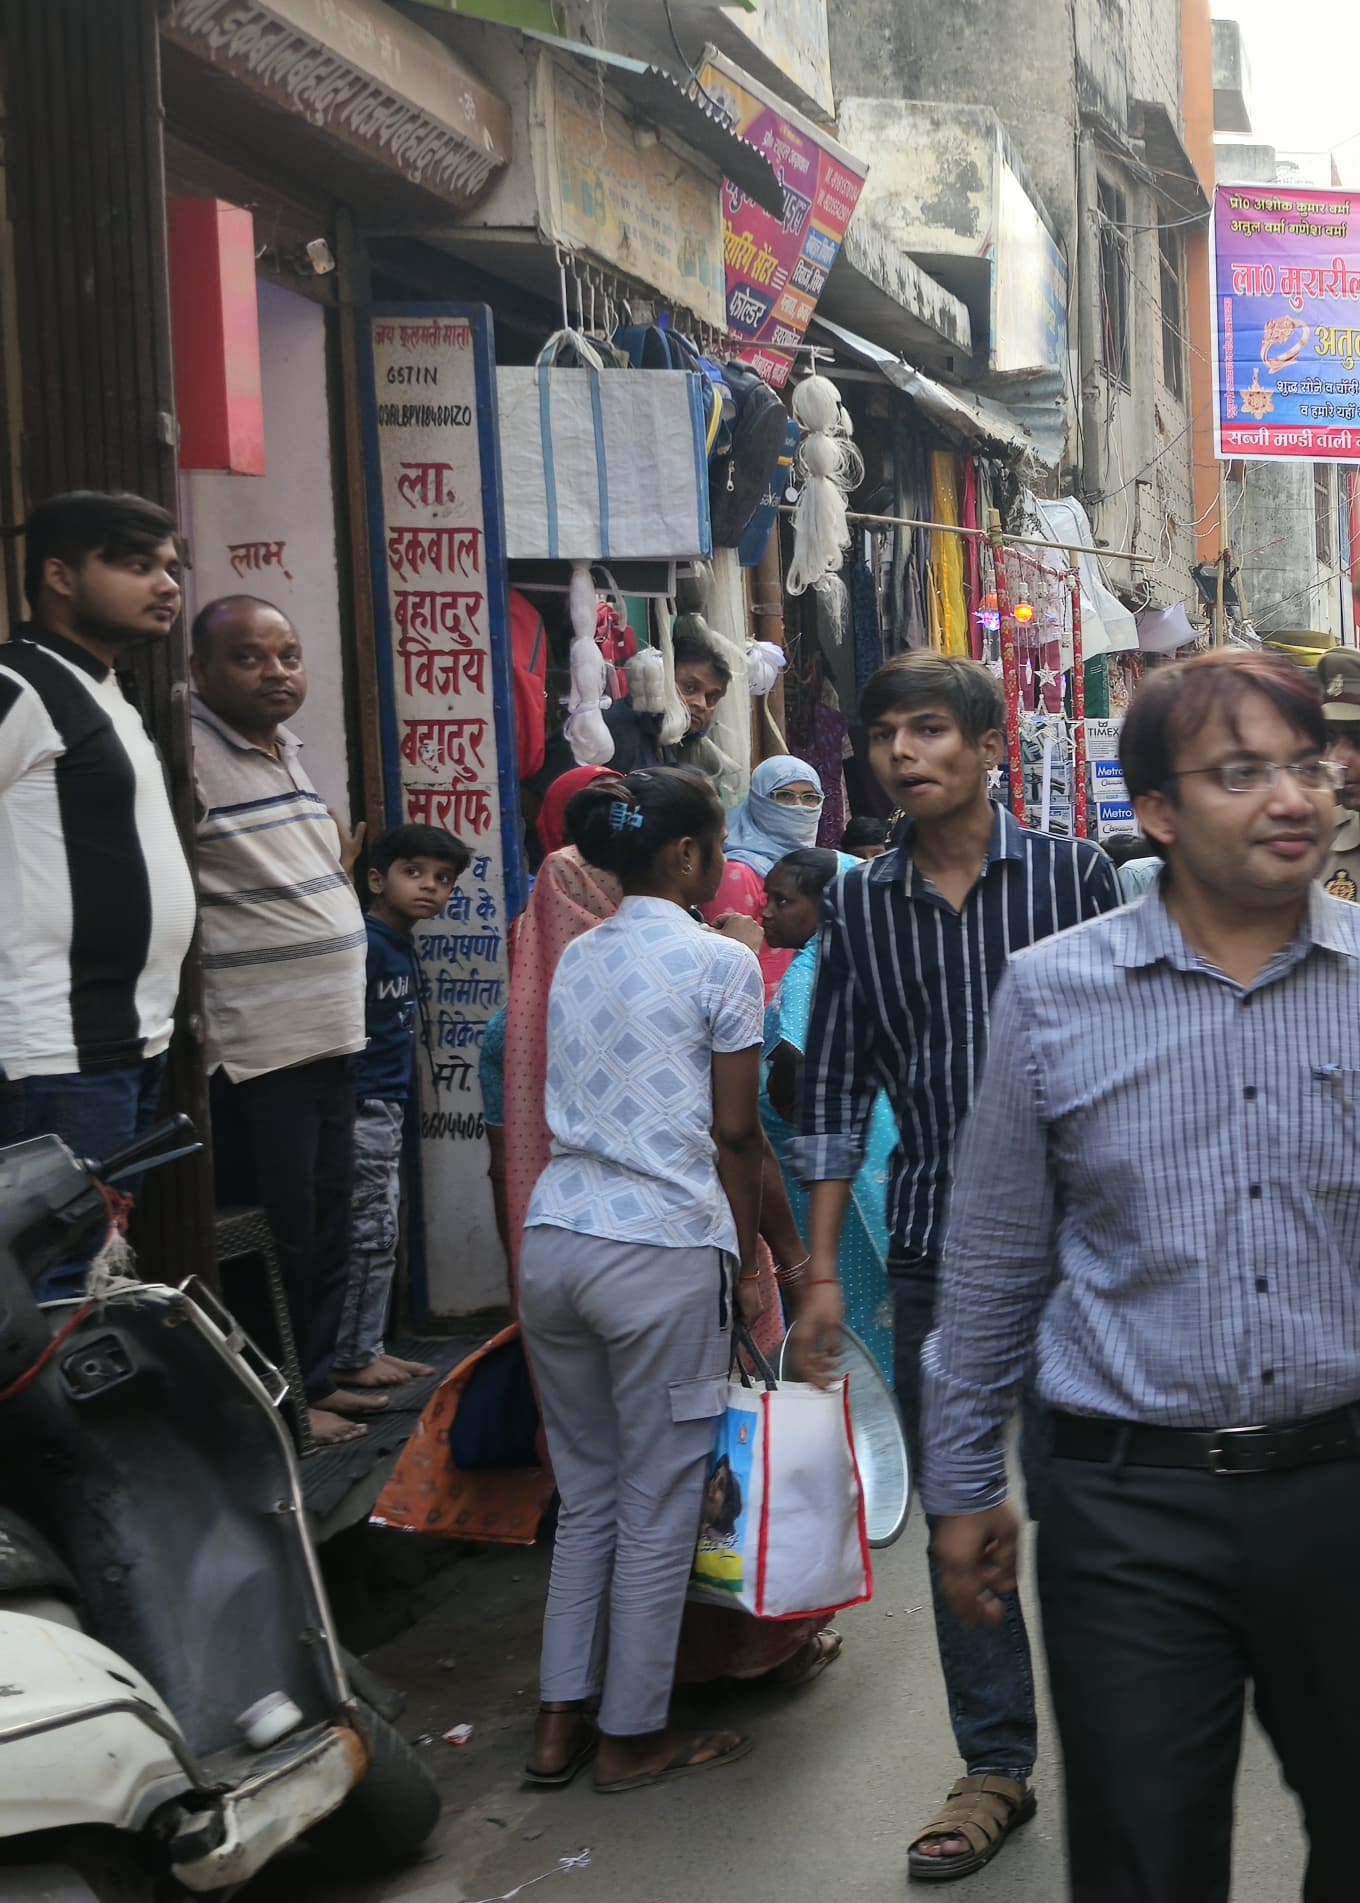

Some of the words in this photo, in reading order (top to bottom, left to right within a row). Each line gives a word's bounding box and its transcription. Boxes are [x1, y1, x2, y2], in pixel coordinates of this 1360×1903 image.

[1254, 198, 1293, 213] अशोक
[1296, 200, 1326, 217] कुमार
[1328, 200, 1351, 215] वर्मा
[1231, 219, 1262, 237] अतुल
[1264, 218, 1286, 235] वर्मा
[1288, 219, 1322, 237] गणेश
[1324, 221, 1348, 238] वर्मा
[374, 323, 395, 345] जय
[442, 323, 474, 351] माता
[386, 365, 439, 386] GSTIN
[1301, 377, 1322, 395] सोने
[1325, 382, 1334, 395] व
[1300, 405, 1309, 418] व
[1310, 401, 1335, 419] हमारे
[1273, 428, 1315, 449] मण्डी
[1316, 429, 1353, 450] वाली
[388, 526, 483, 584] इकबाल
[392, 589, 485, 649] बहादुर
[396, 634, 489, 697] विजय
[1087, 727, 1120, 737] TIMEX
[400, 718, 489, 783] बहादुर
[403, 776, 493, 837] सर्राफ
[1101, 807, 1133, 819] Metro
[475, 887, 497, 922] के
[435, 967, 505, 1011] निर्माता
